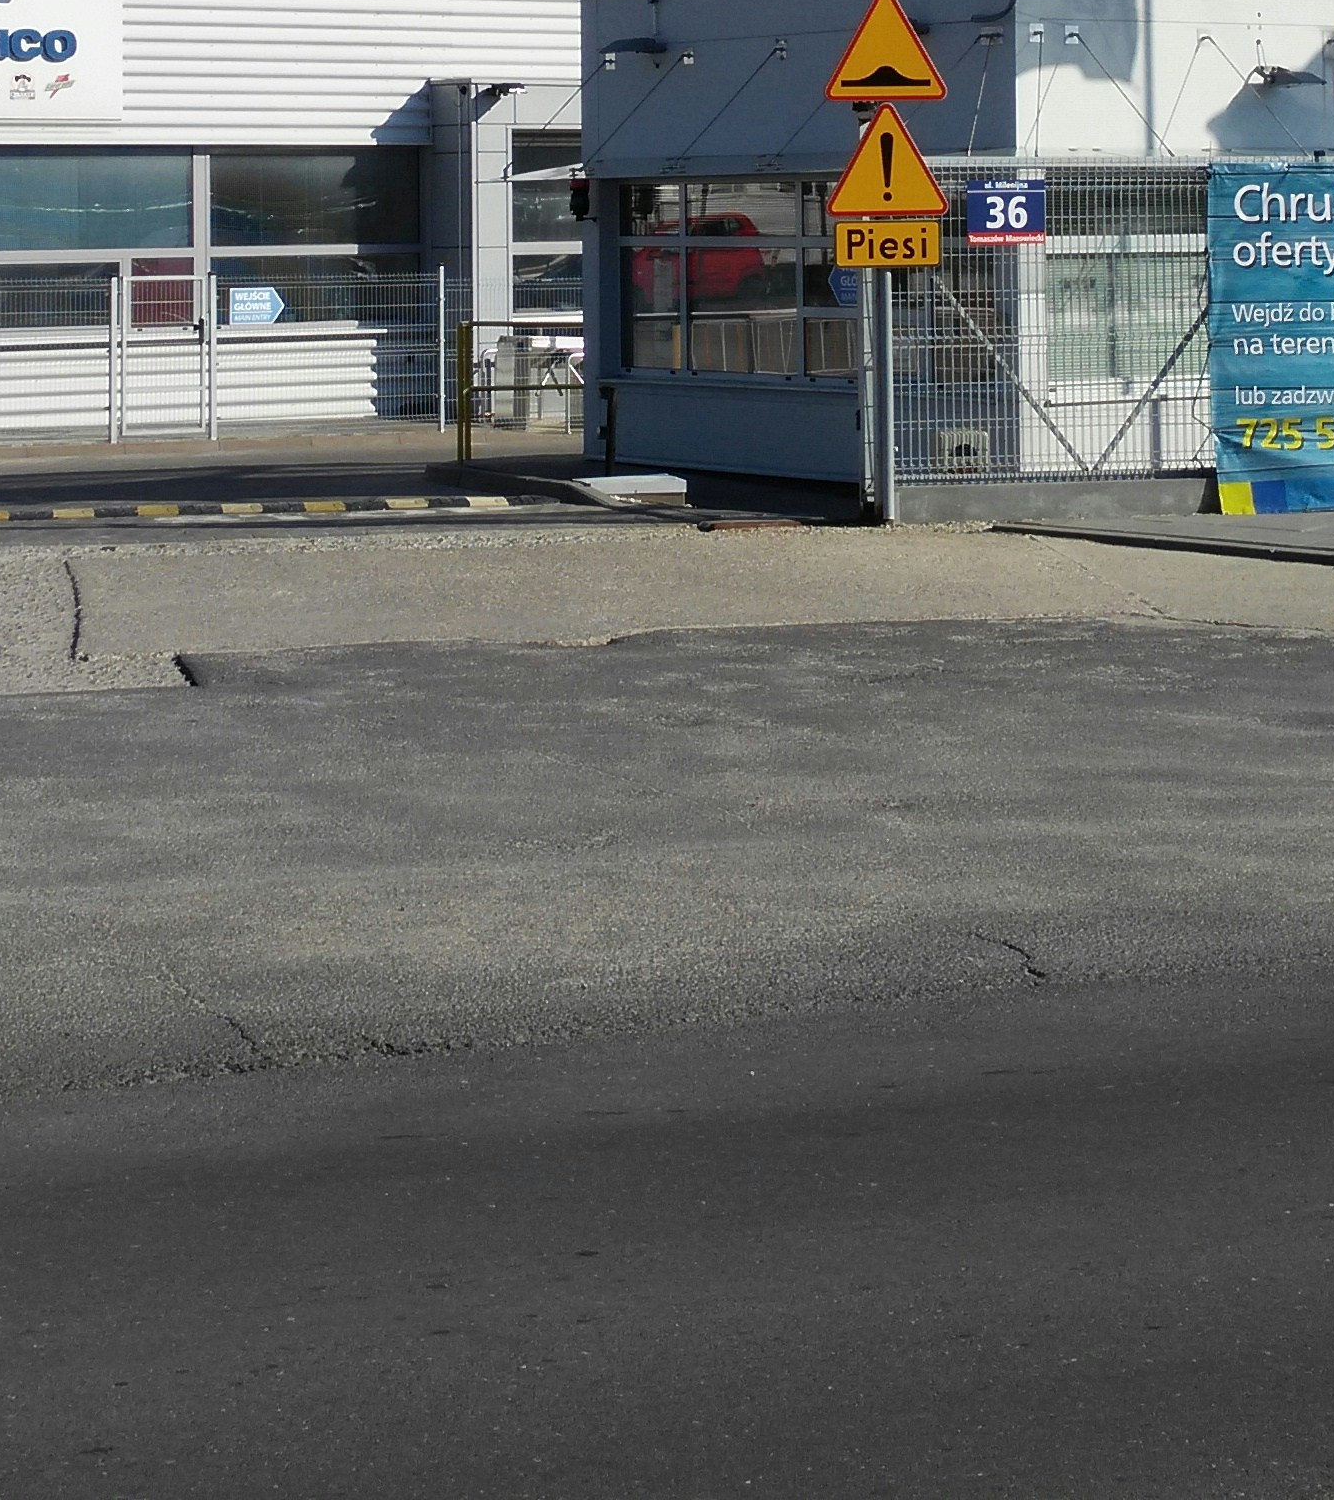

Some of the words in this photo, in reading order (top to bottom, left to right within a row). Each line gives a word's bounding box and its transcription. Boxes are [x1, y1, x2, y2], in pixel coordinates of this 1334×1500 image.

[985, 195, 1028, 229] 36
[846, 227, 928, 261] Piesi
[233, 301, 272, 311] GŁÓWNE
[234, 290, 272, 301] WEJŚCIE
[1232, 302, 1294, 328] Wejdź
[1299, 302, 1325, 322] do
[1233, 337, 1264, 355] na
[1234, 385, 1267, 406] lub
[1236, 417, 1305, 451] 725
